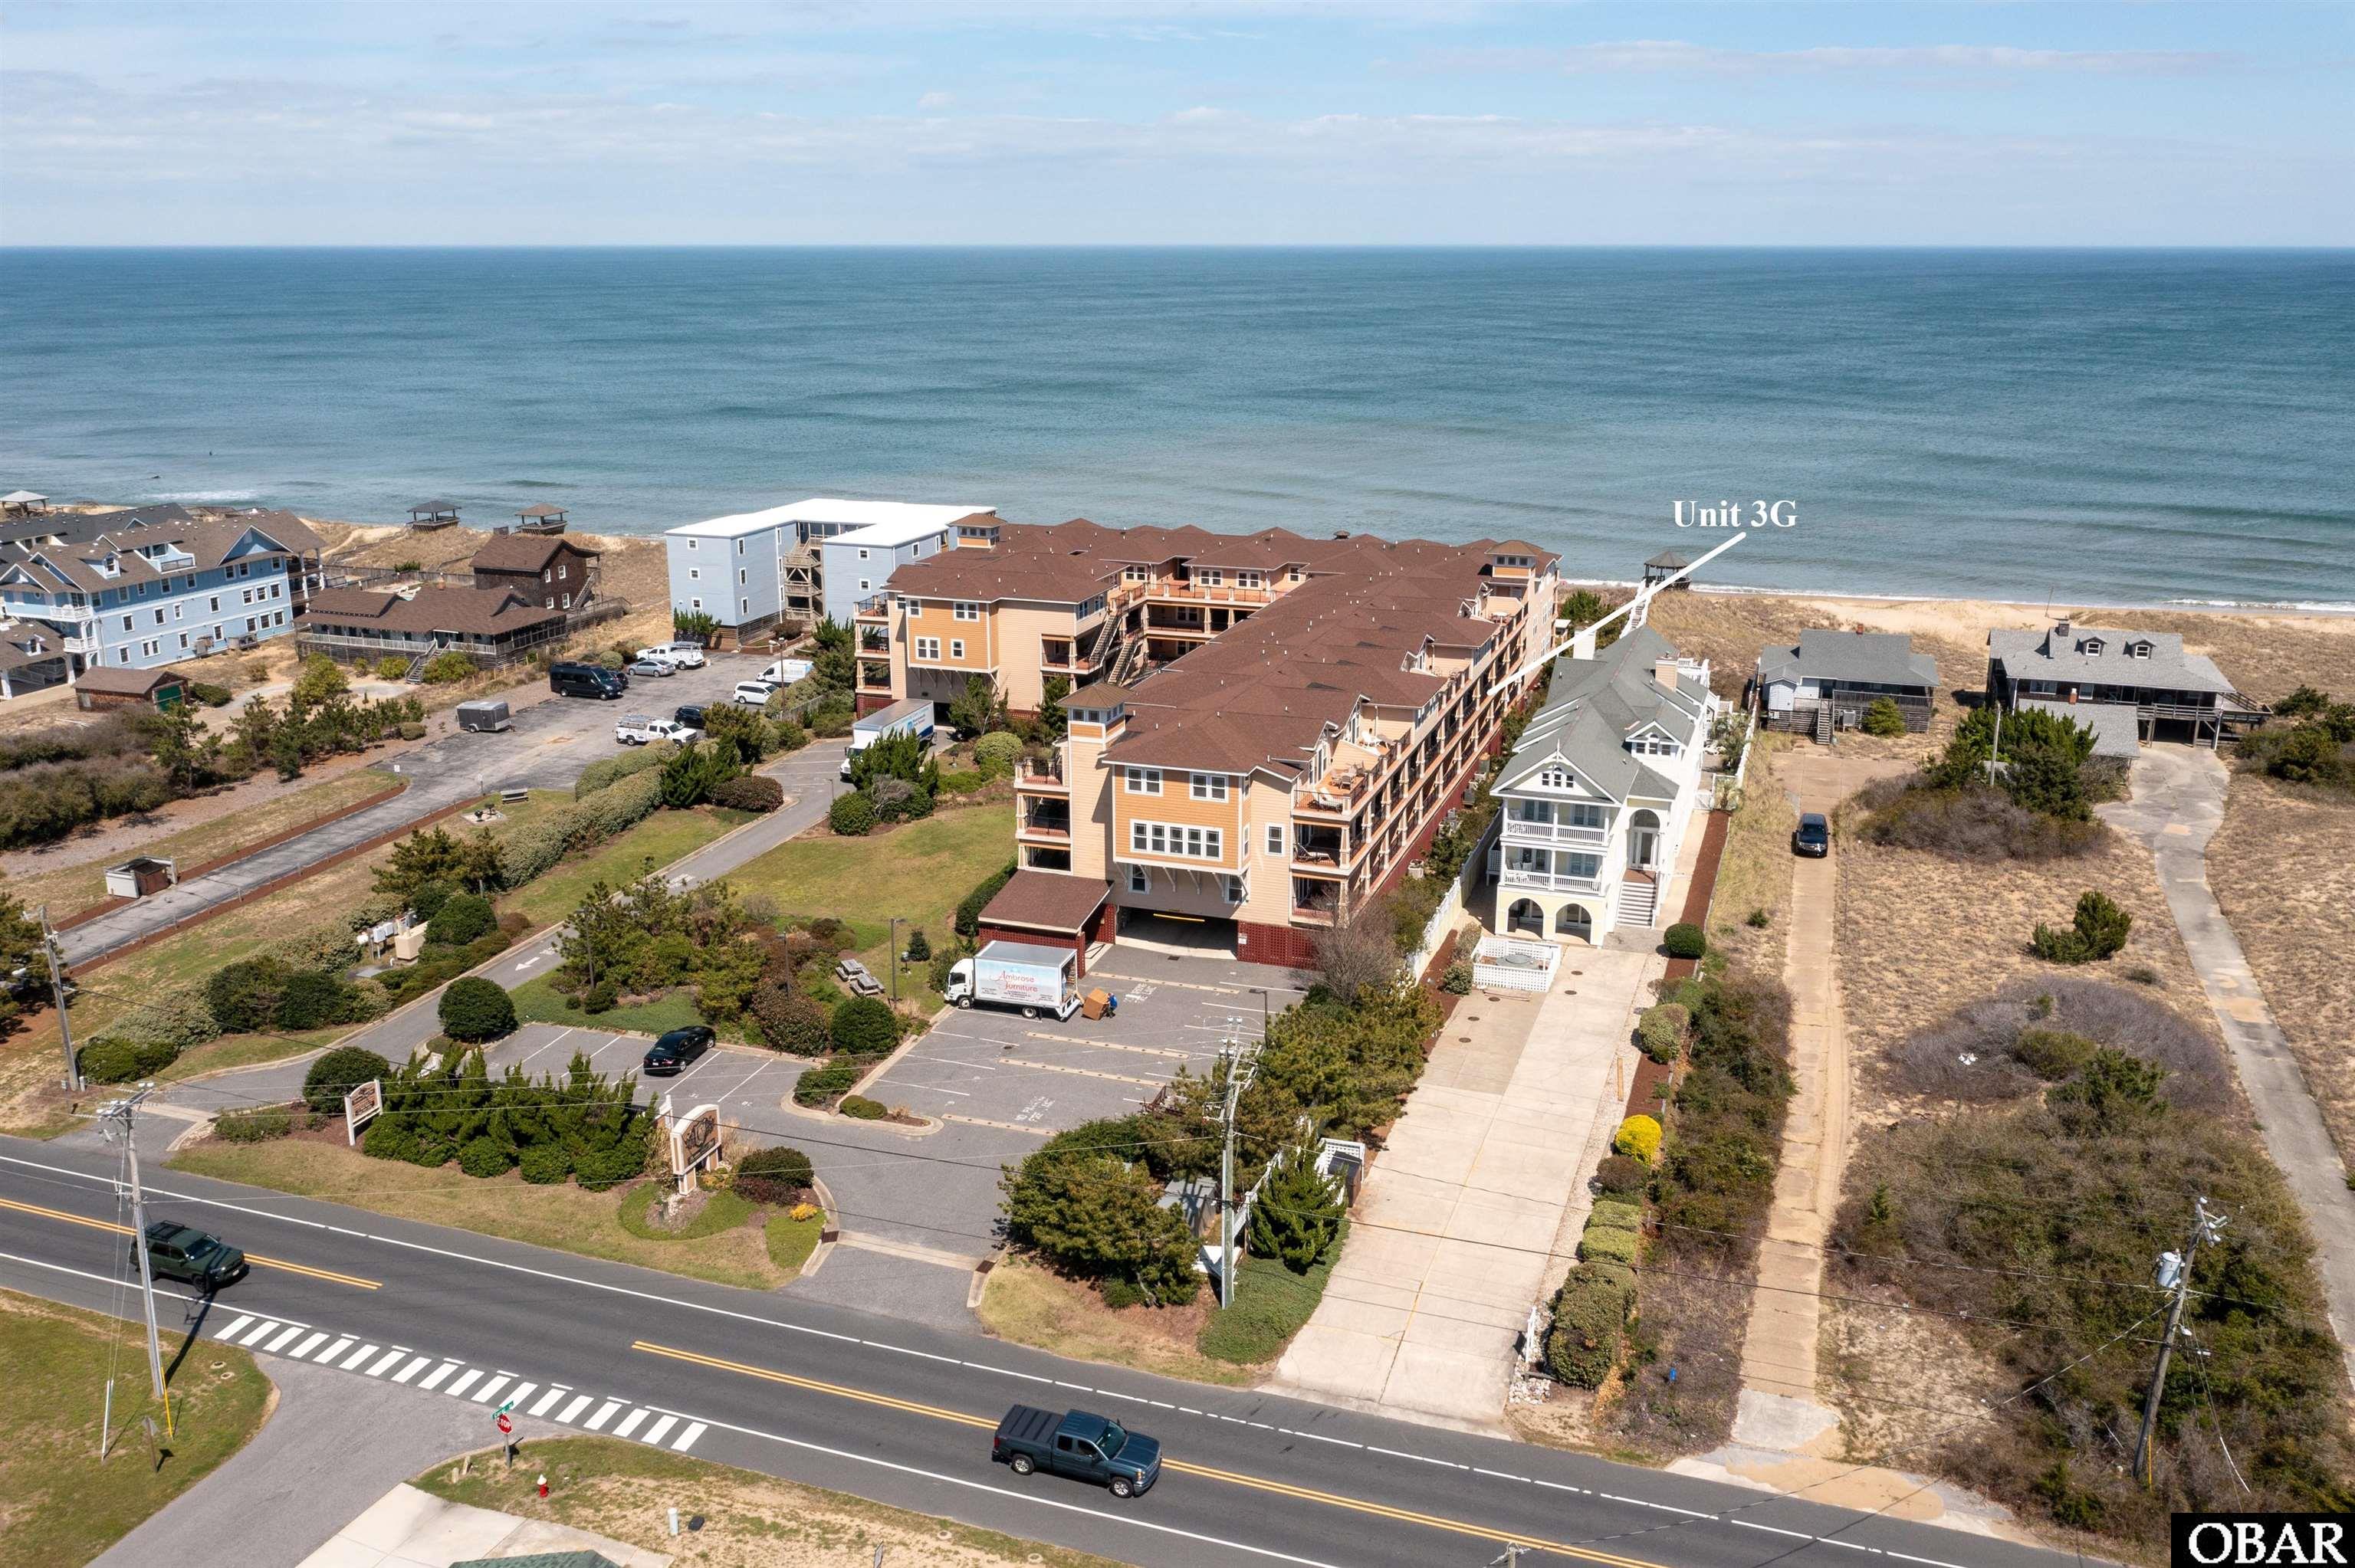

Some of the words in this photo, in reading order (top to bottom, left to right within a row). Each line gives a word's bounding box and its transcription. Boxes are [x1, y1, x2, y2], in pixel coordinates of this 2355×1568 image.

[990, 970, 1035, 982] Ambrose
[999, 981, 1039, 992] Furniture
[497, 1417, 511, 1429] STOP
